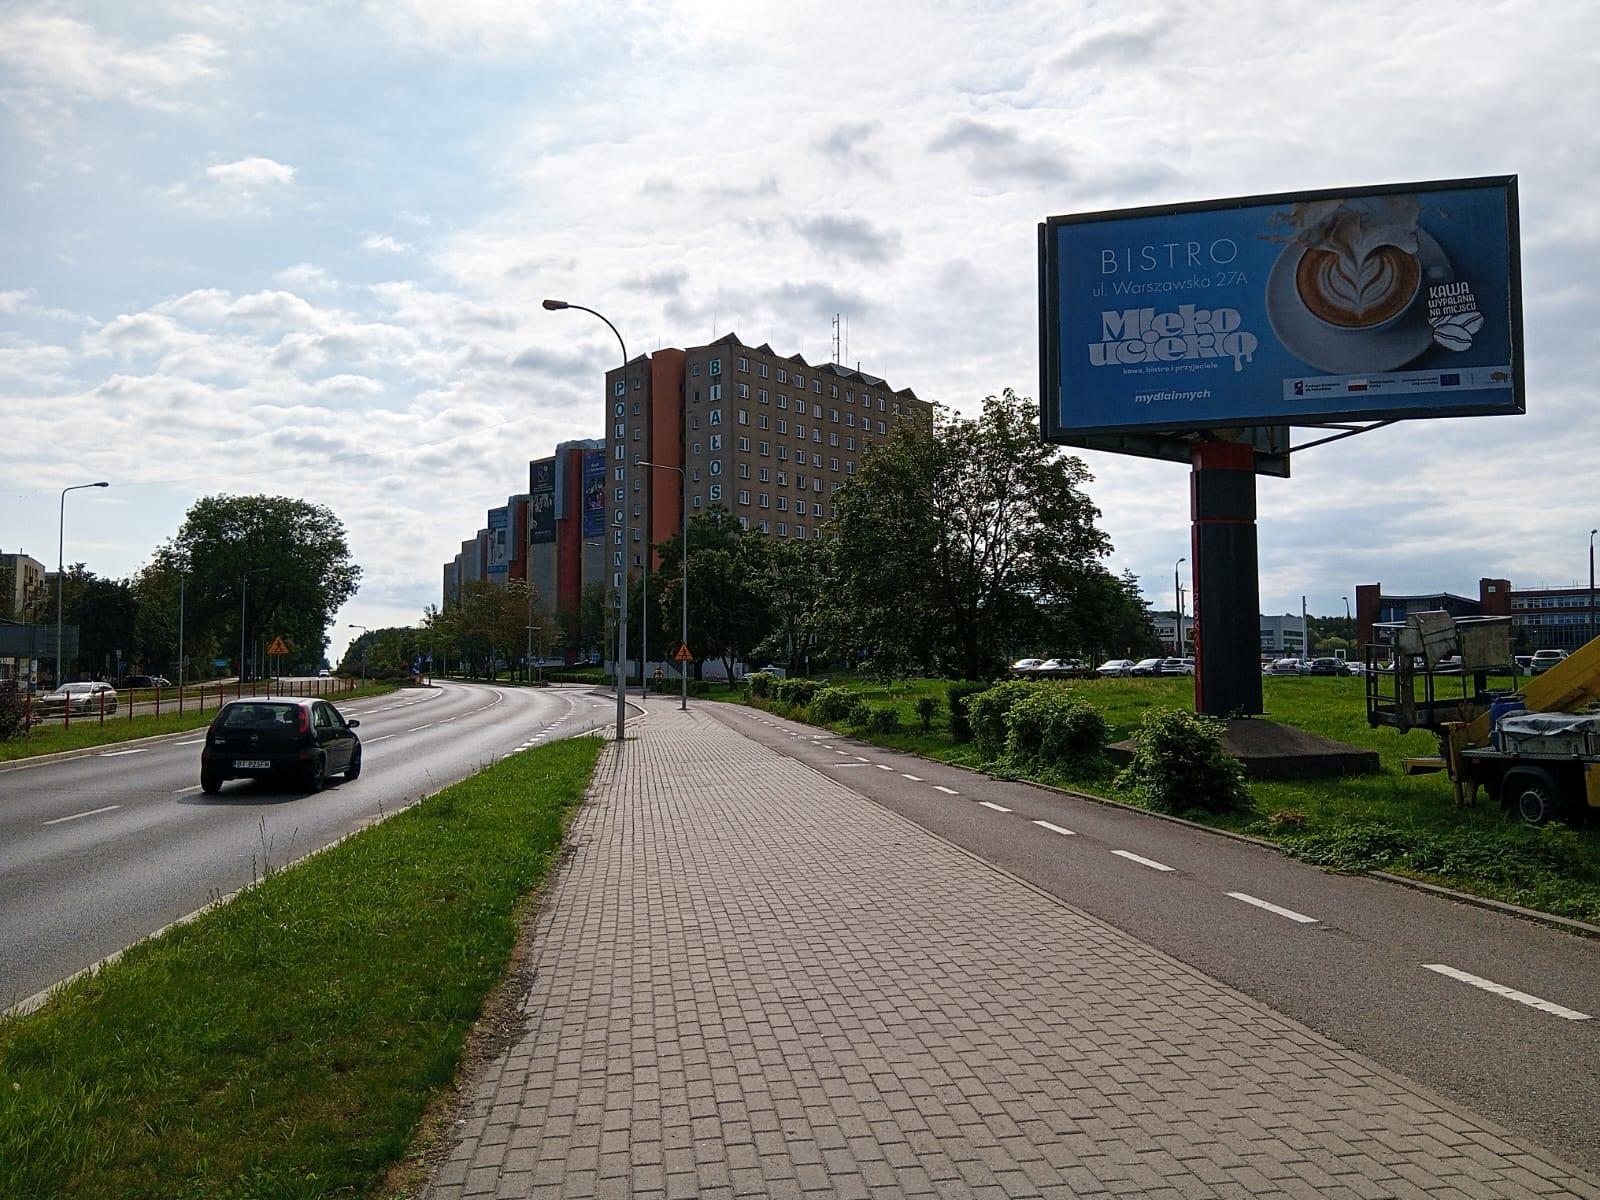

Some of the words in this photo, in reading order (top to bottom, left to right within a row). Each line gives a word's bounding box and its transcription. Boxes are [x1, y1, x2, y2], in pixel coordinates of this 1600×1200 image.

[1102, 238, 1237, 274] BISTRO
[1092, 282, 1108, 297] ul.
[1112, 274, 1211, 296] Warszawska
[1215, 271, 1248, 287] 27A
[1429, 281, 1470, 299] KAWA
[1428, 293, 1475, 308] WYPALANA
[1429, 307, 1441, 317] NA
[1101, 304, 1242, 342] Mleko
[1135, 390, 1211, 404] mydlainnych
